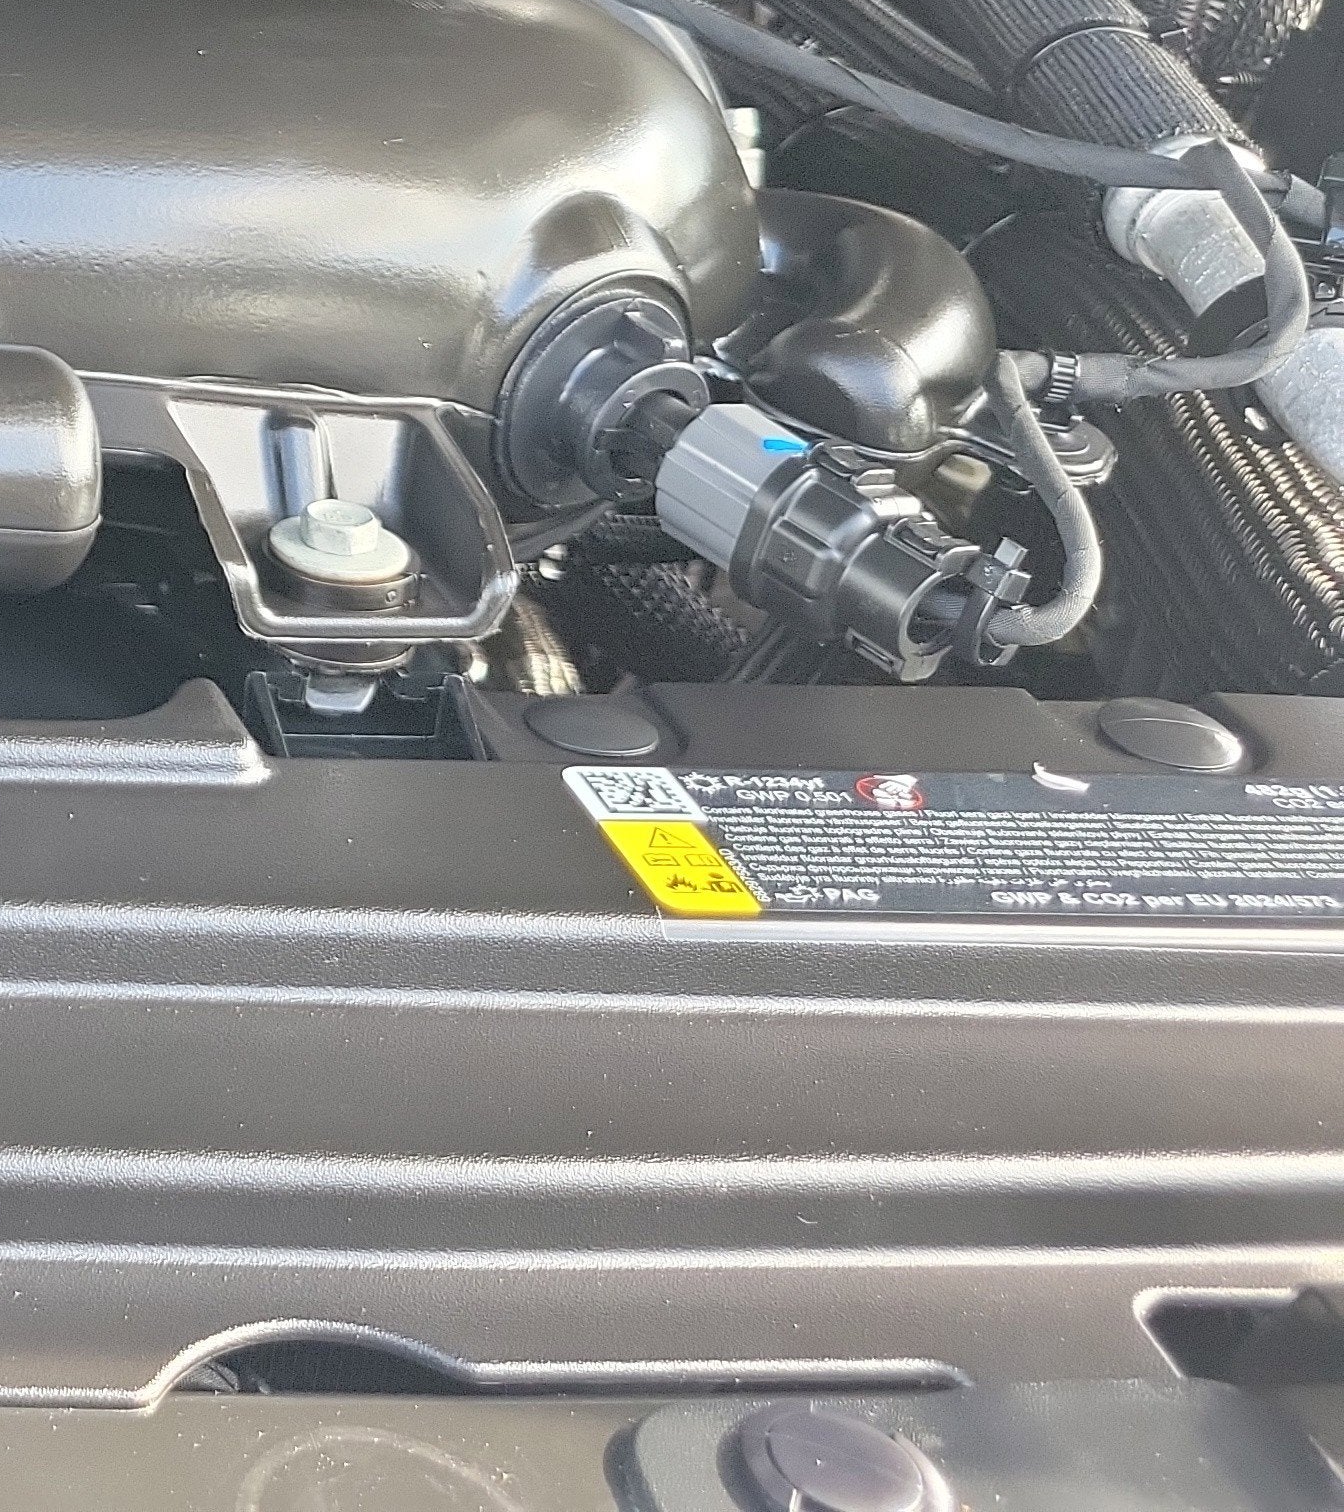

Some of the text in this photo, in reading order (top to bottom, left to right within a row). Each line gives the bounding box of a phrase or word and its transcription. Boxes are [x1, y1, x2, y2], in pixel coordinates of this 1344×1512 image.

[723, 776, 825, 790] R-1234yf
[736, 790, 852, 803] GWP 0.501
[1272, 798, 1325, 808] CO2
[700, 806, 754, 814] Contains
[813, 809, 883, 818] greenhouse
[823, 888, 880, 902] PAG
[990, 891, 1052, 904] GWP
[1057, 892, 1081, 905] &
[1082, 892, 1141, 906] CO2
[1141, 894, 1184, 908] per
[1186, 893, 1229, 907] EU
